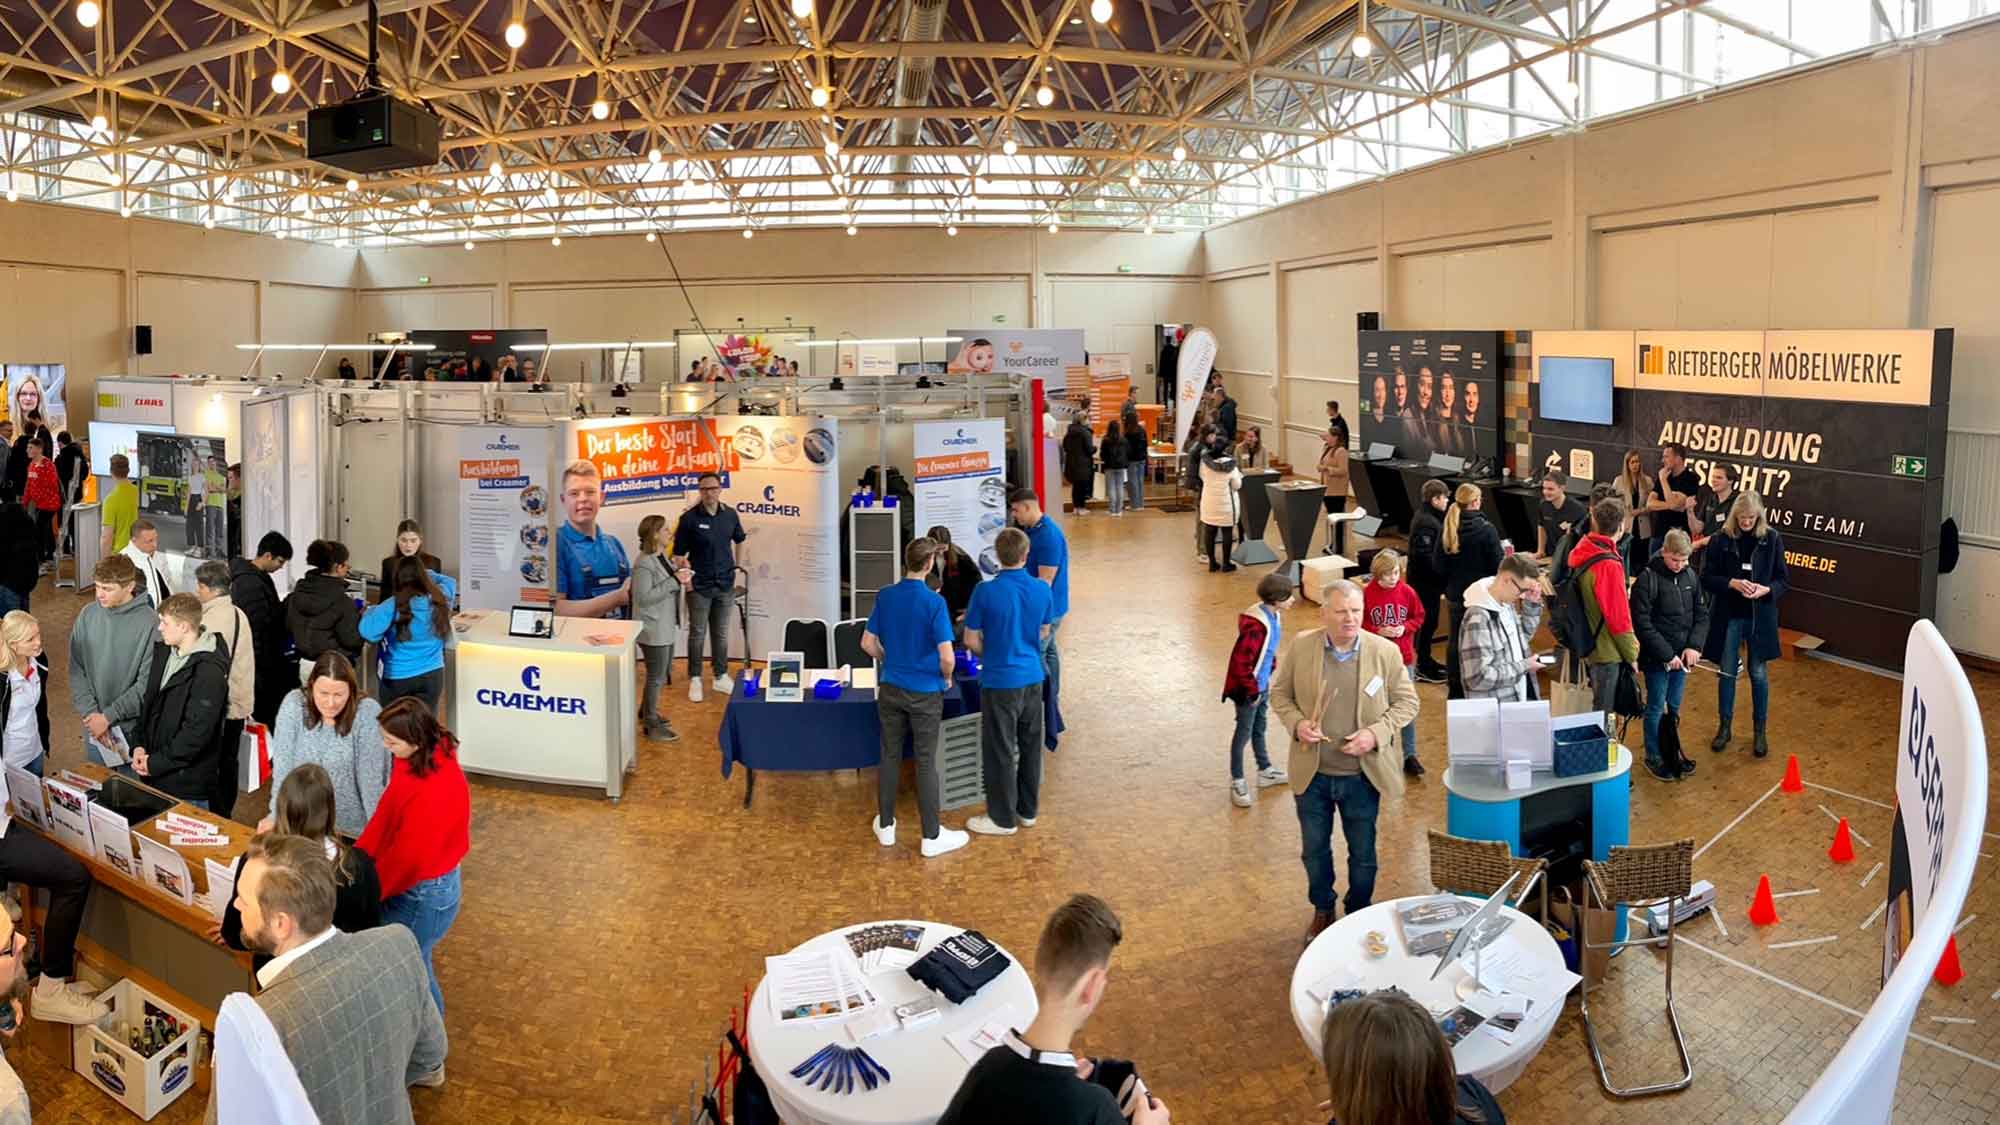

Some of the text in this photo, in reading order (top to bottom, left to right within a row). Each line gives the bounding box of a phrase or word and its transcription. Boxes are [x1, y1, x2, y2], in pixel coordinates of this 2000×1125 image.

[1004, 356, 1059, 367] YourCareer
[1668, 345, 1902, 384] RIETBERGER MÖBELWERKE
[587, 422, 698, 458] Der beste Start
[1658, 420, 1823, 464] AUSBILDUNG
[602, 438, 734, 477] in deine Zukunft
[604, 474, 725, 493] Ausbildung bei Crar
[736, 502, 801, 517] CRAEMER
[1803, 513, 1865, 538] TEAM!
[1783, 550, 1837, 573] RIERE.DE
[1370, 603, 1408, 625] GAP
[476, 688, 587, 715] CRAEMER
